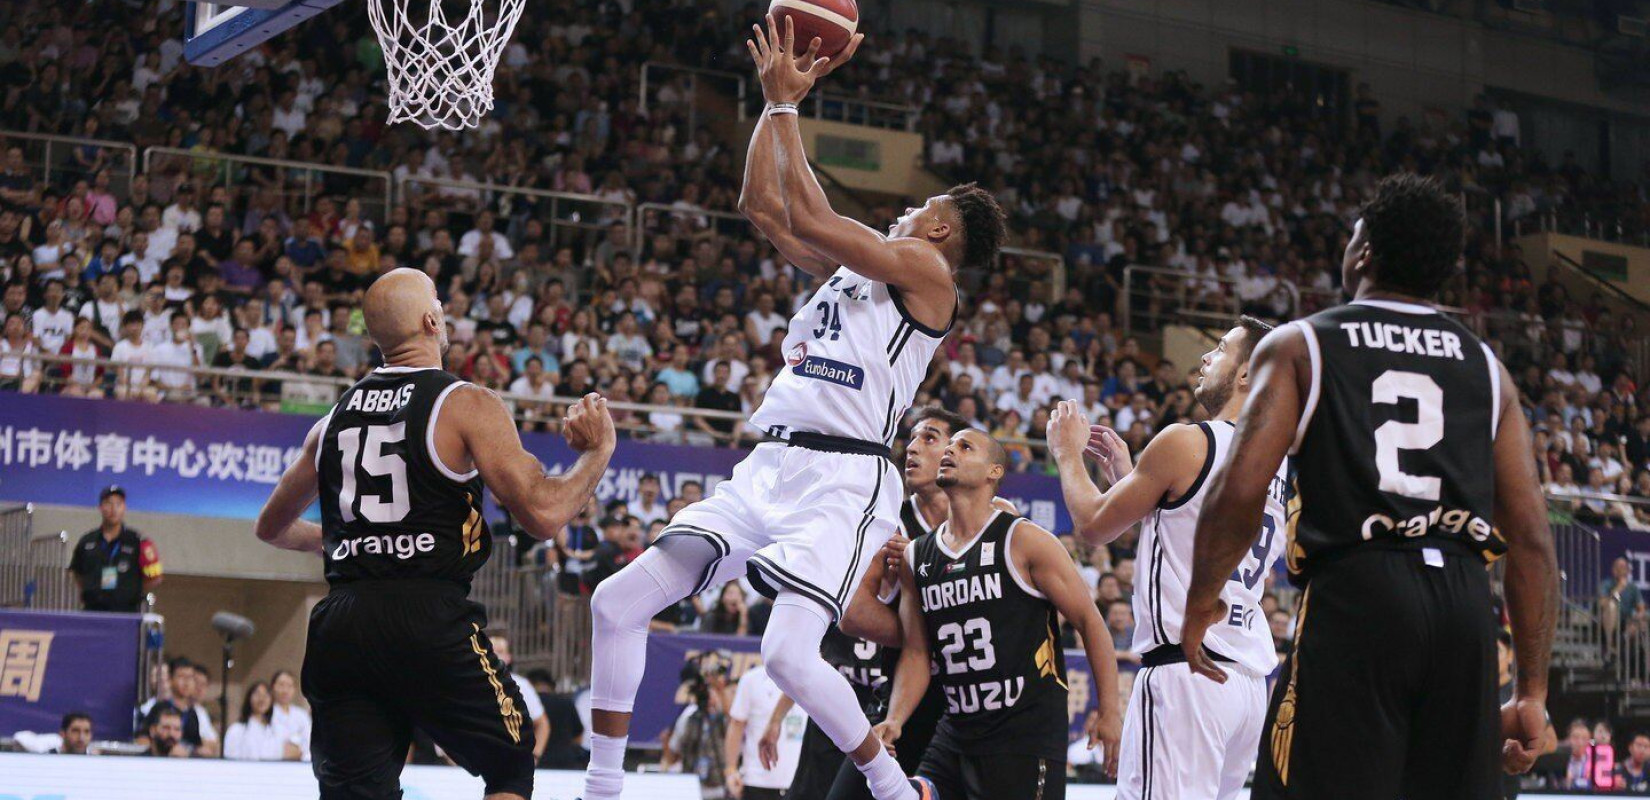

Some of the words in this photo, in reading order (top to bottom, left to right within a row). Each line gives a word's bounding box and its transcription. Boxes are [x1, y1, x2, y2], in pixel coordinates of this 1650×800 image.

[813, 301, 842, 341] 34
[1340, 322, 1465, 361] TUCKER
[804, 360, 857, 385] Eurobank
[346, 383, 415, 412] ABBAS
[1371, 369, 1445, 502] 2
[338, 421, 411, 524] 15
[332, 532, 436, 560] orange
[922, 573, 1003, 613] JORDAN
[937, 616, 997, 675] 23
